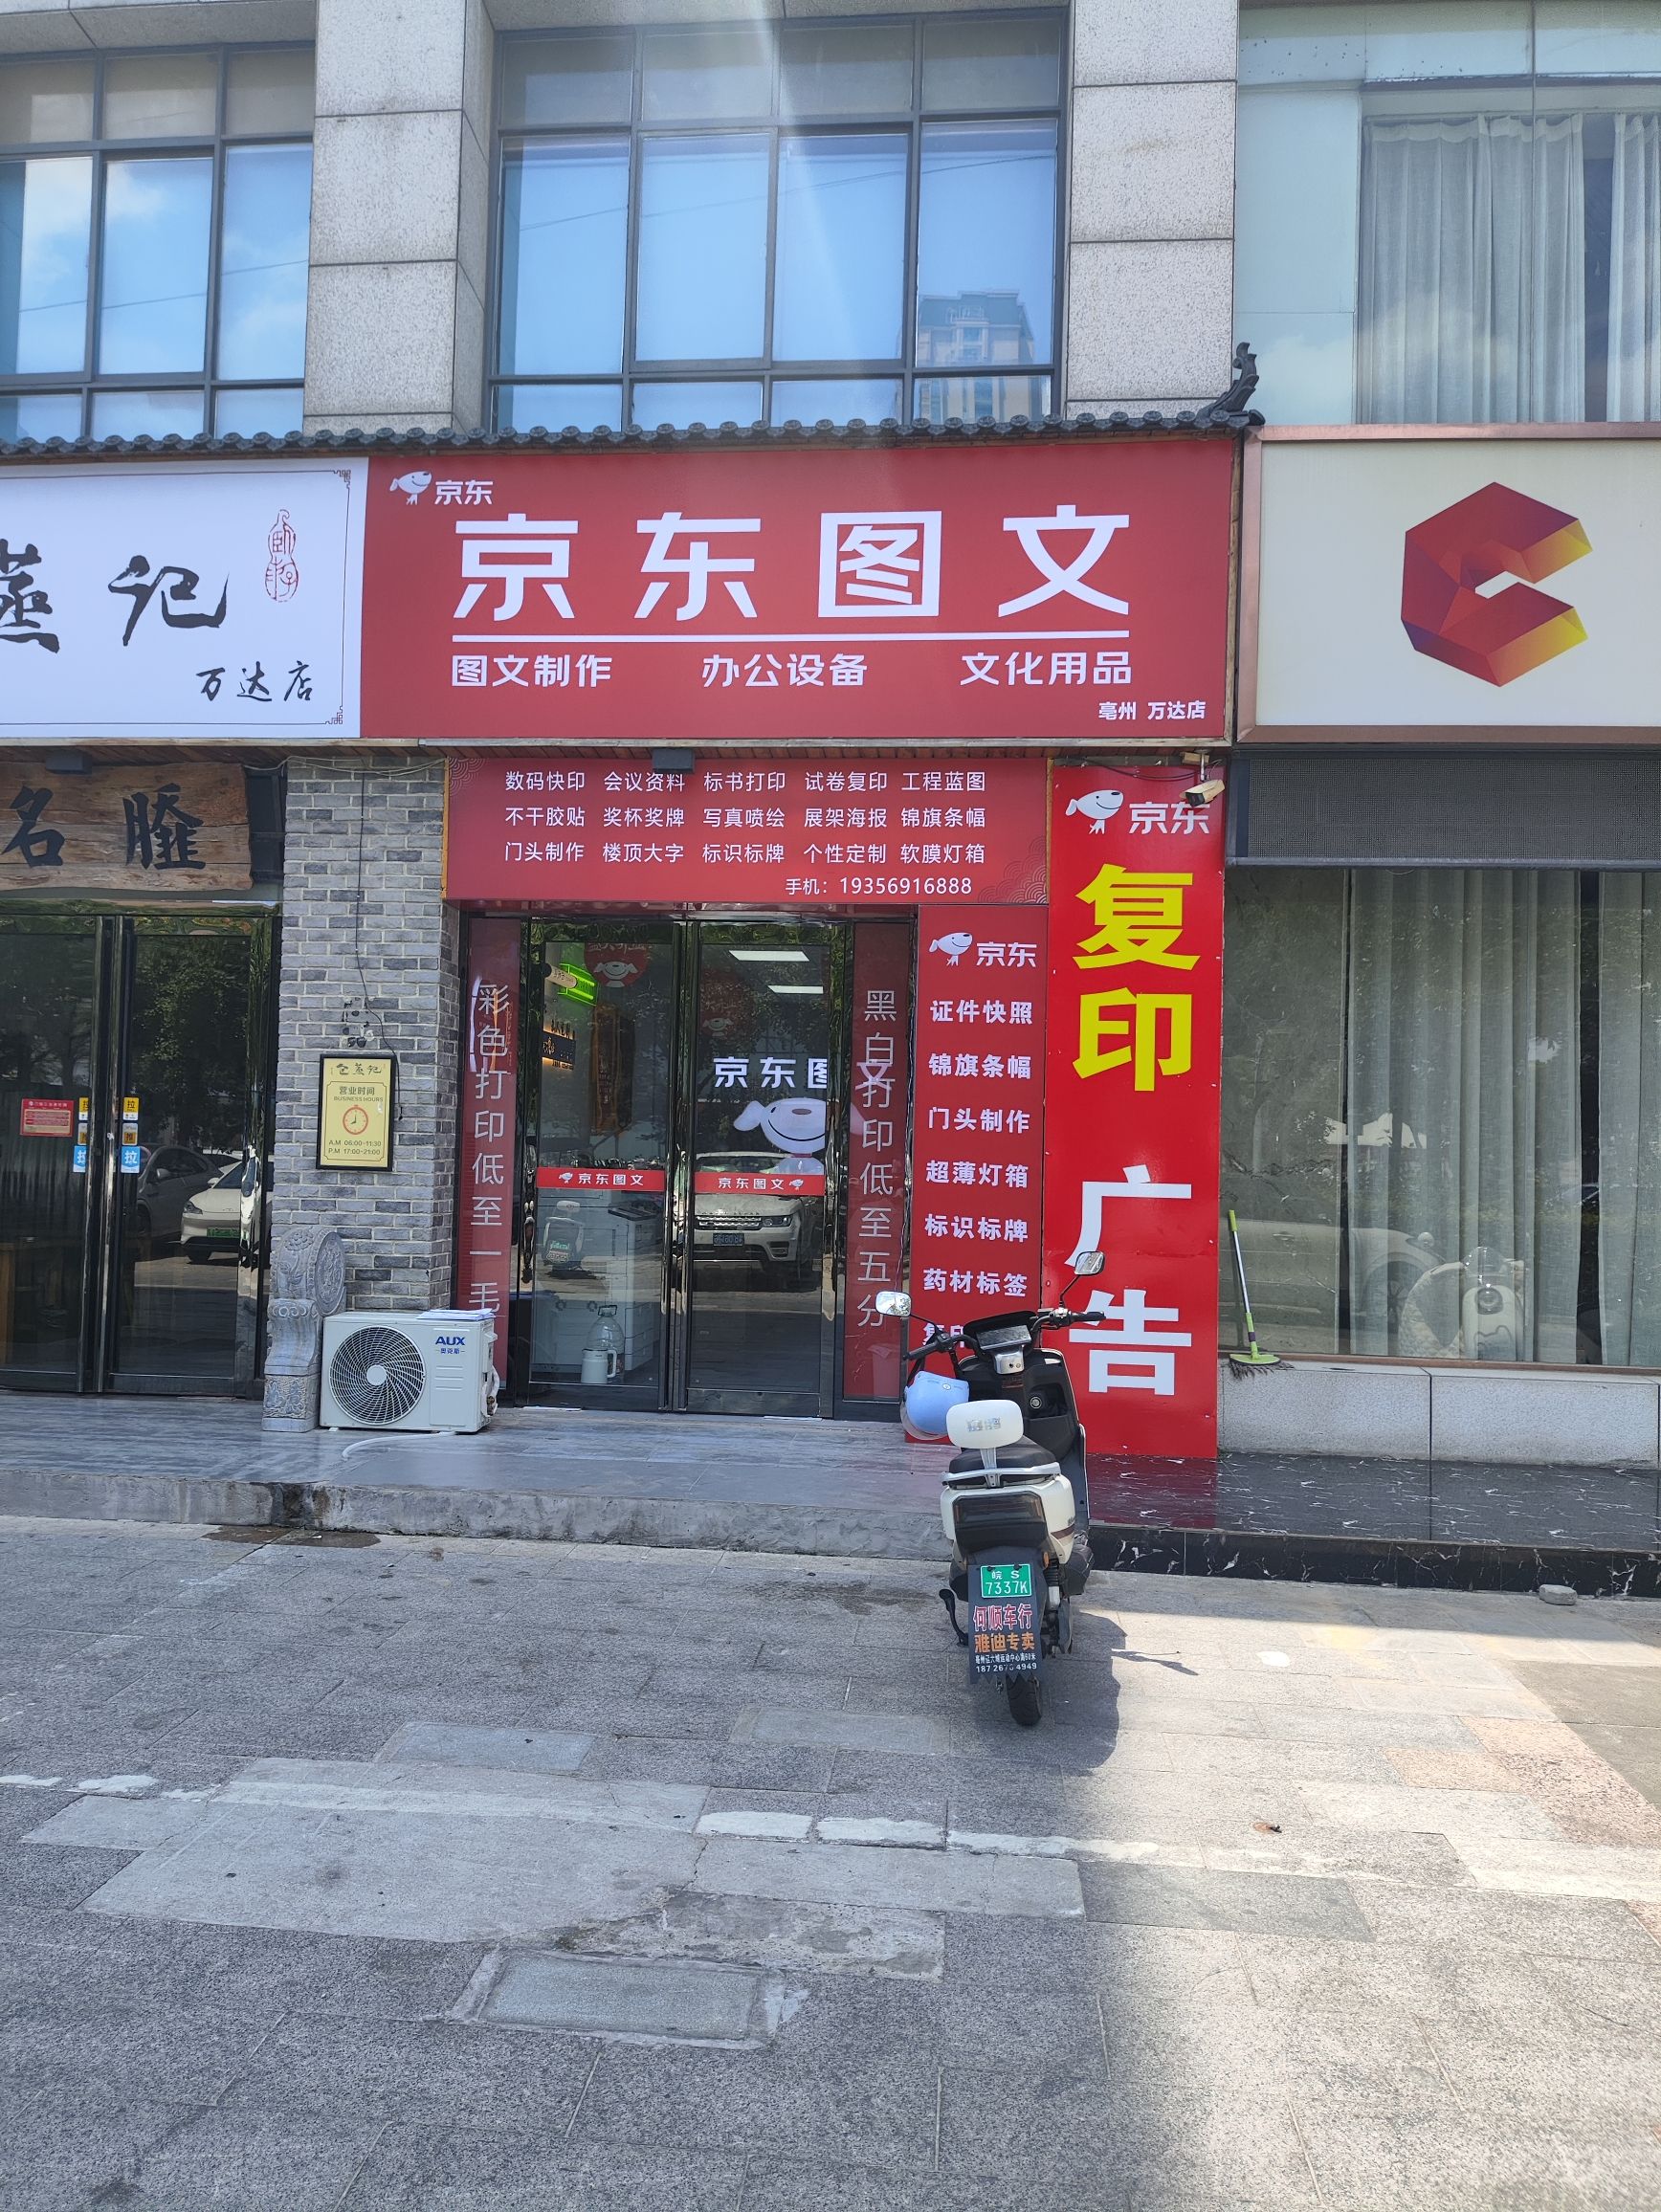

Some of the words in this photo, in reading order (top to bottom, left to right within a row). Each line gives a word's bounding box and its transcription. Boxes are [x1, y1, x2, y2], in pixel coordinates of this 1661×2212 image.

[434, 480, 494, 505] 京东
[453, 504, 1130, 621] 京东图文
[195, 661, 313, 702] 万达店
[452, 654, 612, 687] 图文制作
[702, 653, 868, 687] 办公设备
[960, 652, 1132, 686] 文化用品
[1148, 700, 1206, 719] 万达店
[505, 771, 586, 792] 数码快印
[603, 771, 685, 792] 会议资料
[703, 771, 786, 792] 标书打印
[805, 771, 888, 792] 试卷复印
[901, 771, 986, 792] 工程蓝图
[505, 807, 586, 828] 不干胶贴
[603, 807, 685, 829] 奖杯奖牌
[702, 807, 786, 829] 写真喷绘
[804, 807, 888, 829] 展架海报
[901, 807, 986, 829] 锦旗条幅
[1128, 802, 1210, 835] 京东
[504, 842, 585, 862] 门头制作
[602, 843, 685, 863] 楼顶大字
[702, 843, 786, 864] 标识标牌
[803, 844, 887, 864] 个性定制
[900, 844, 986, 864] 软膜灯箱
[976, 941, 1038, 967] 京东
[1073, 863, 1201, 1092] 复印
[929, 1000, 1033, 1025] 证件快照
[928, 1053, 1032, 1079] 锦旗条幅
[340, 1087, 375, 1095] 营业时间
[928, 1107, 1030, 1134] 门头制作
[124, 1151, 138, 1164] 拉
[468, 984, 510, 1312] 彩色打印低至一毛
[857, 990, 897, 1326] 黑白打印低至五分
[578, 1173, 644, 1186] 京东图文
[718, 1178, 785, 1190] 京东图文
[925, 1160, 1030, 1188] 超薄灯箱
[923, 1213, 1029, 1243] 标识标牌
[923, 1268, 1028, 1298] 药材标签
[1064, 1164, 1192, 1396] 广告
[435, 1337, 465, 1345] AUX
[991, 1571, 1003, 1580] 皖
[1010, 1570, 1020, 1579] S
[986, 1582, 1028, 1595] 7337K
[973, 1604, 1032, 1631] 何顺车行
[974, 1632, 1035, 1653] 雅迪专卖
